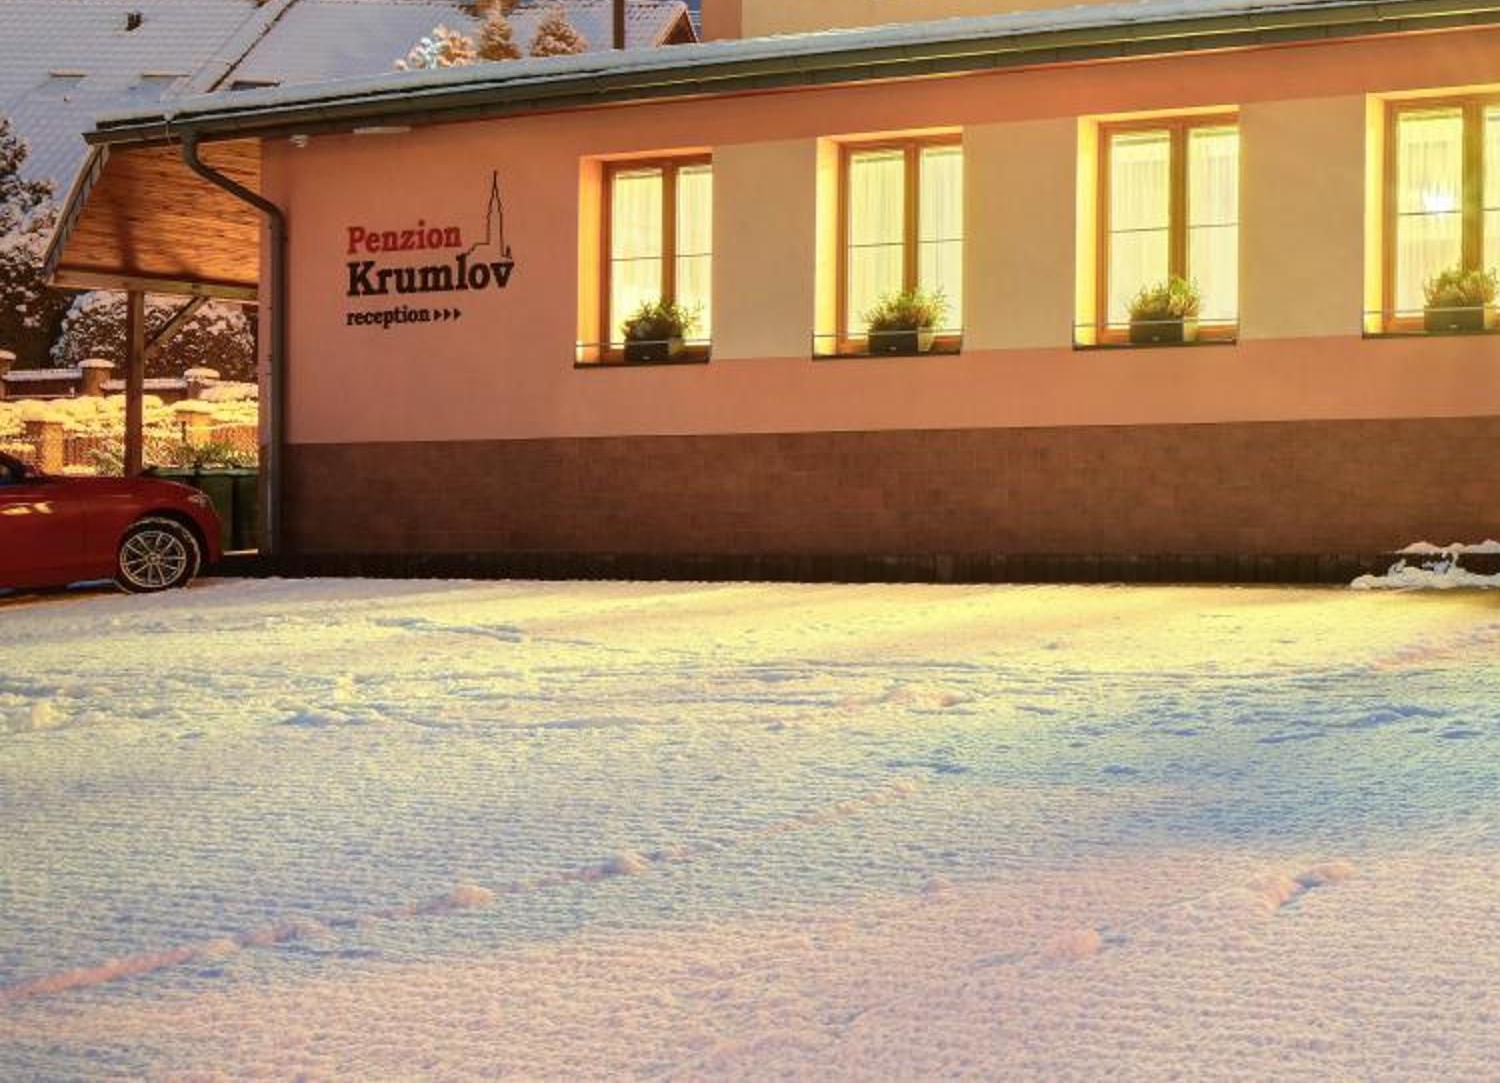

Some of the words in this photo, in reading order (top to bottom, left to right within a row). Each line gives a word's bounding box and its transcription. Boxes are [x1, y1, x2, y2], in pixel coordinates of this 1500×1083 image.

[347, 220, 461, 255] Penzion
[346, 254, 514, 296] Krumlov
[346, 306, 430, 329] reception
